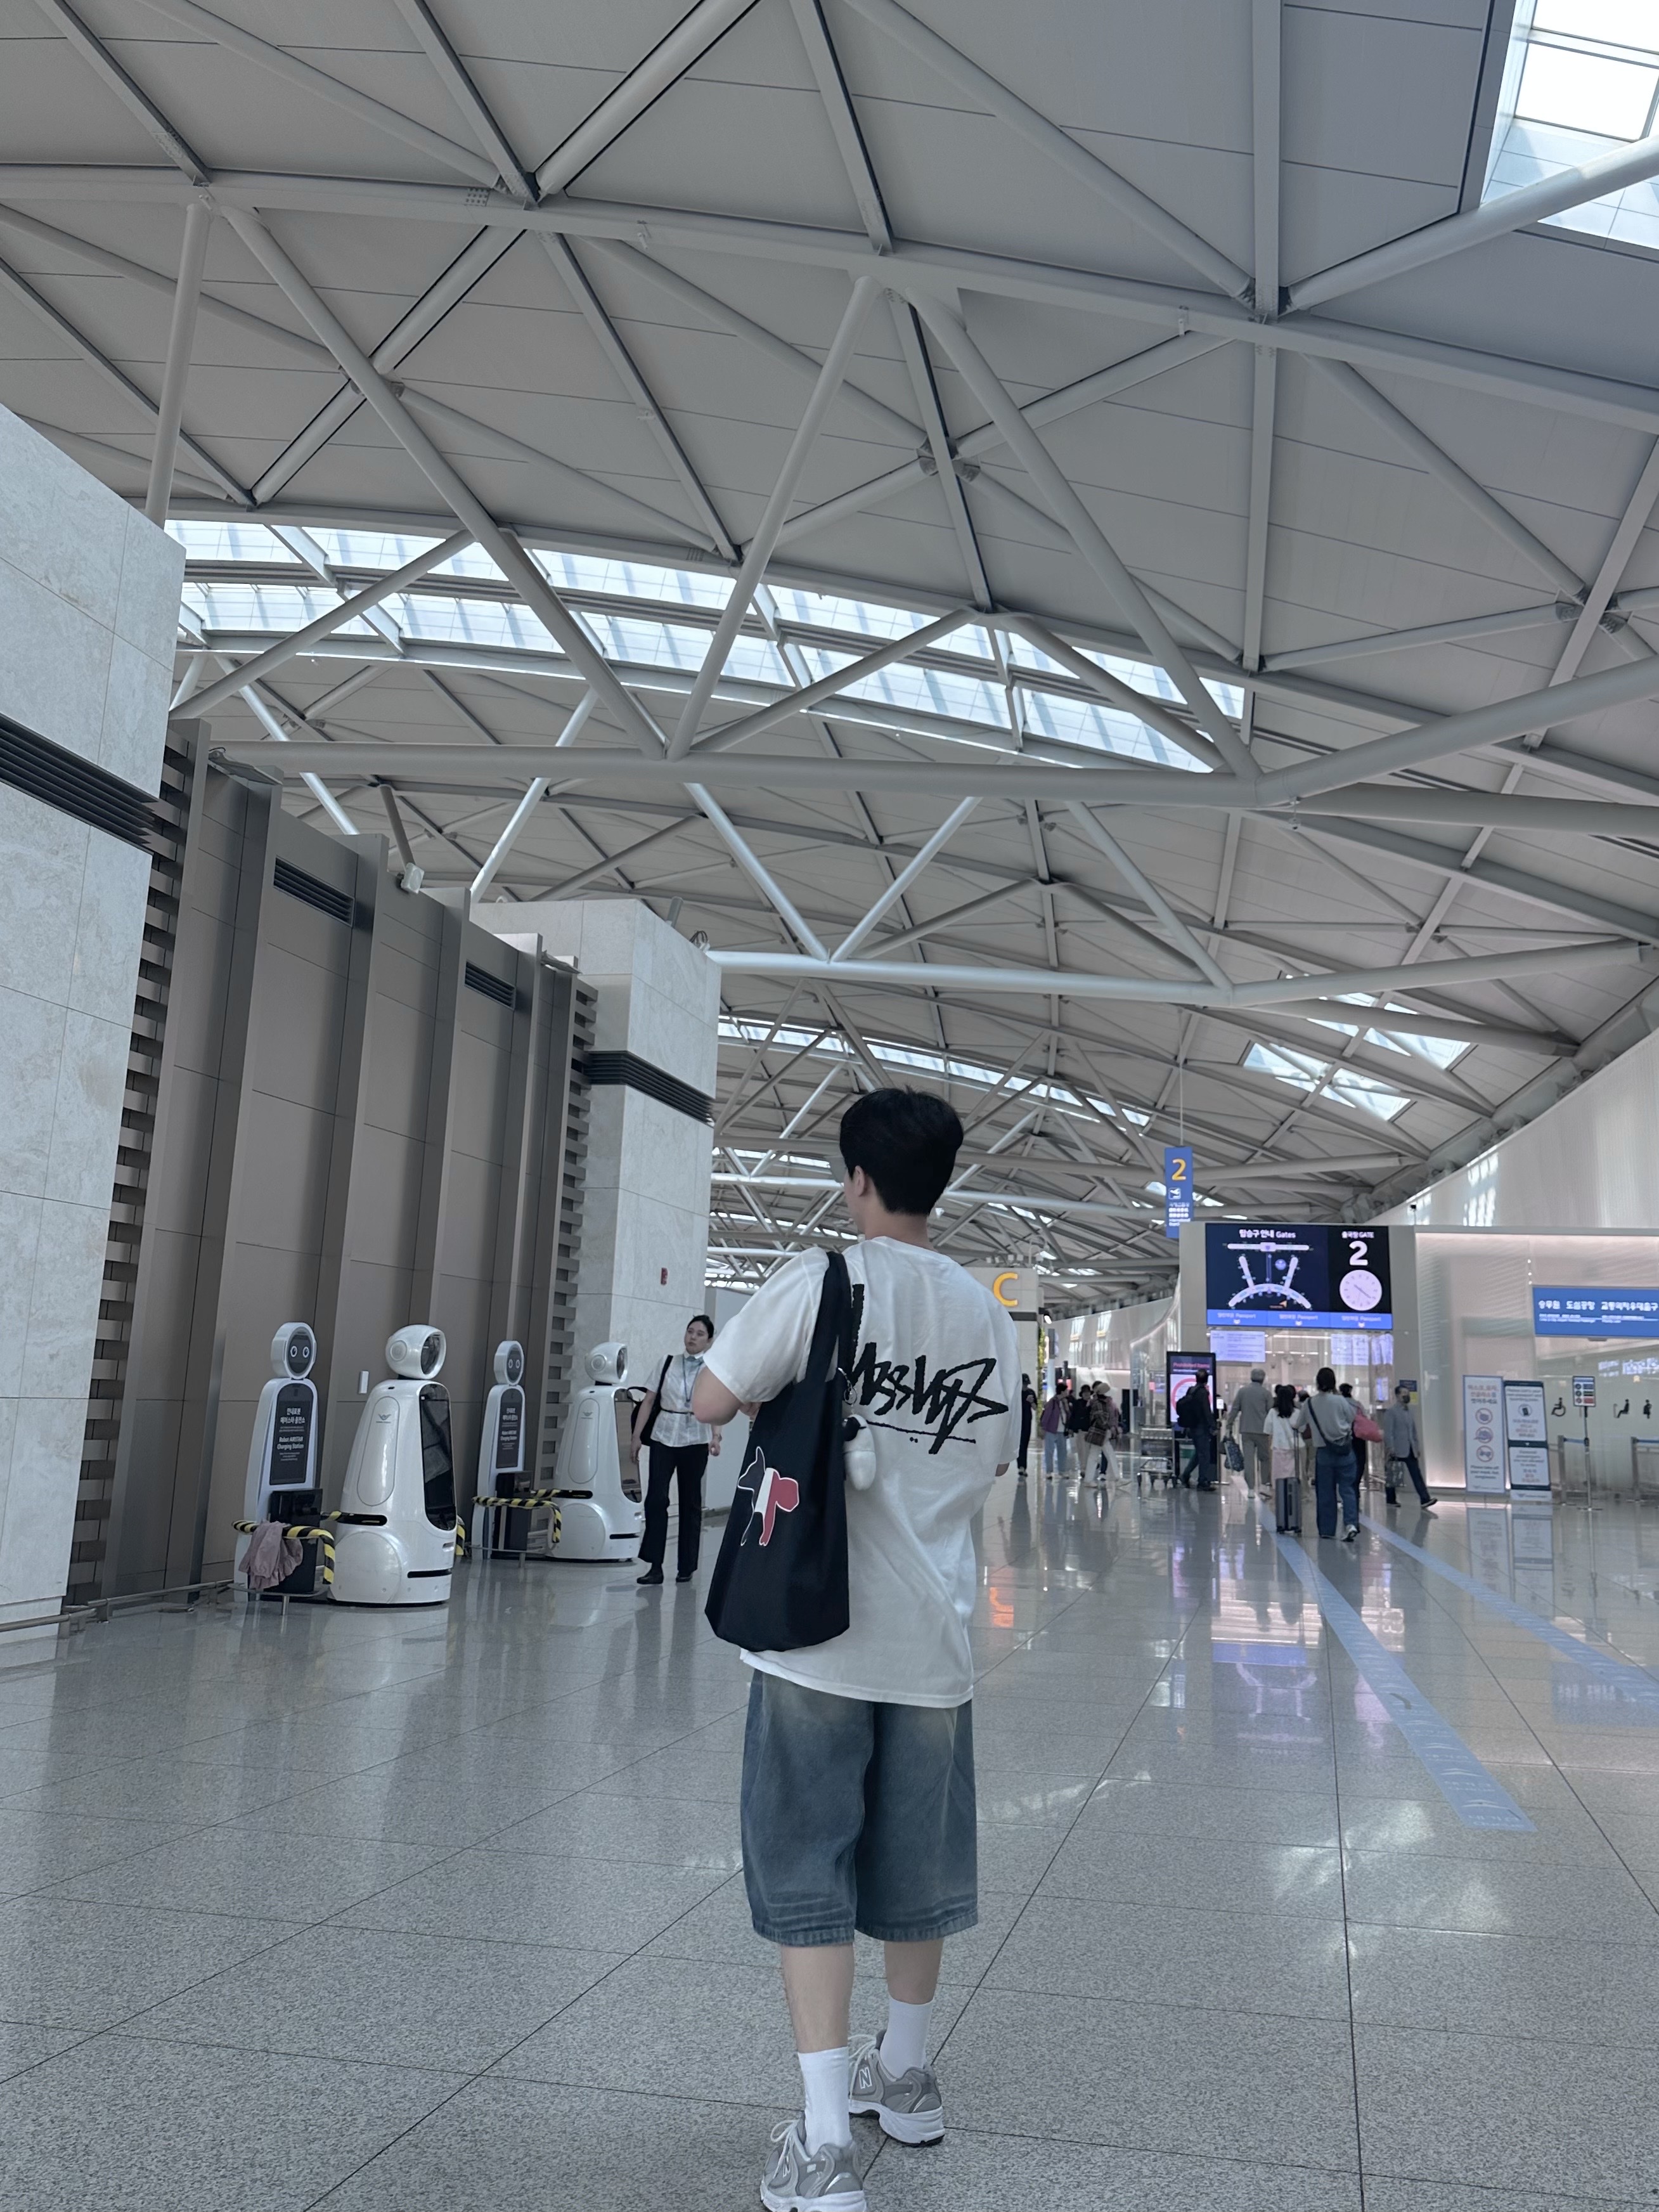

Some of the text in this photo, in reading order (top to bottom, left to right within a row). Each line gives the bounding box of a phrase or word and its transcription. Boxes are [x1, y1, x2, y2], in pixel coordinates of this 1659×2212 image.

[1172, 1158, 1186, 1180] 2
[1349, 1240, 1368, 1265] 2
[993, 1272, 1018, 1307] C
[859, 2067, 872, 2089] N
